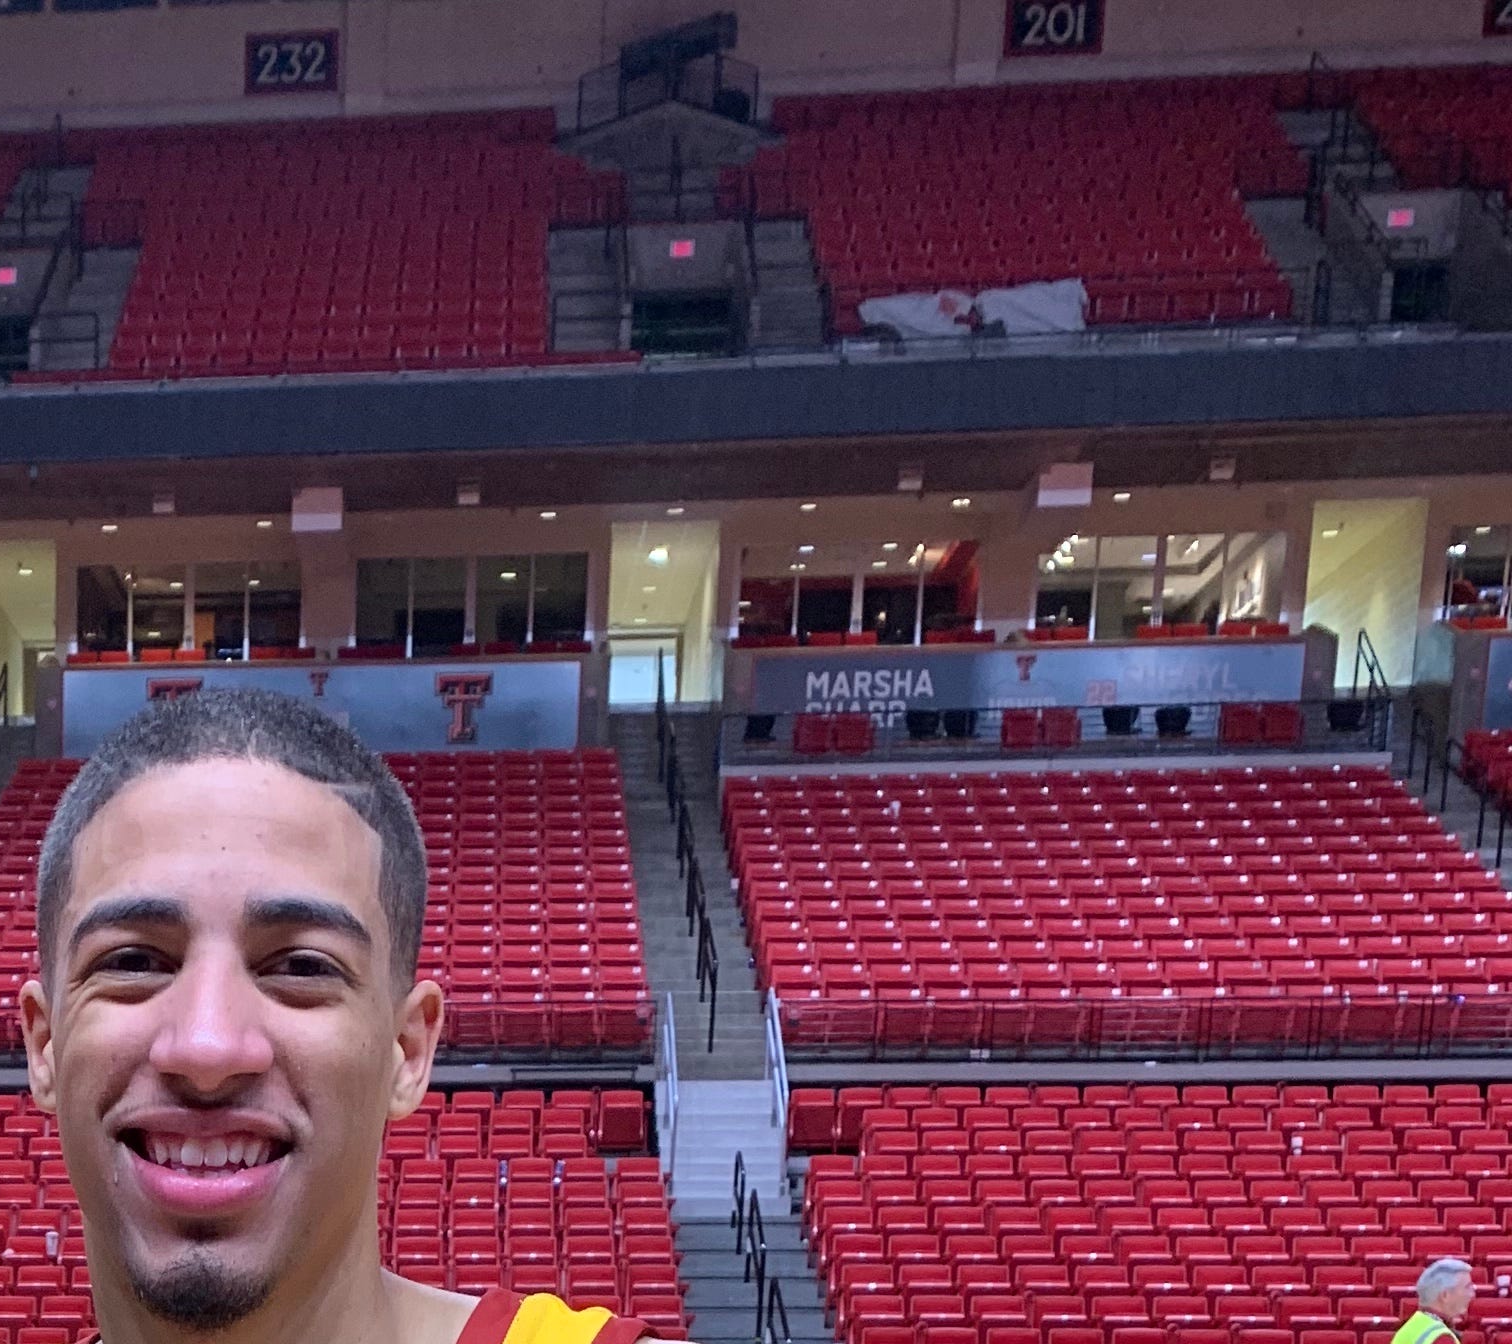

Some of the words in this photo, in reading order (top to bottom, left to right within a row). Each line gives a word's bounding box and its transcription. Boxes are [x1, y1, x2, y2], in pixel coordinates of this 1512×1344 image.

[1020, 1, 1087, 46] 201
[256, 40, 326, 85] 232
[805, 668, 935, 700] MARSHA
